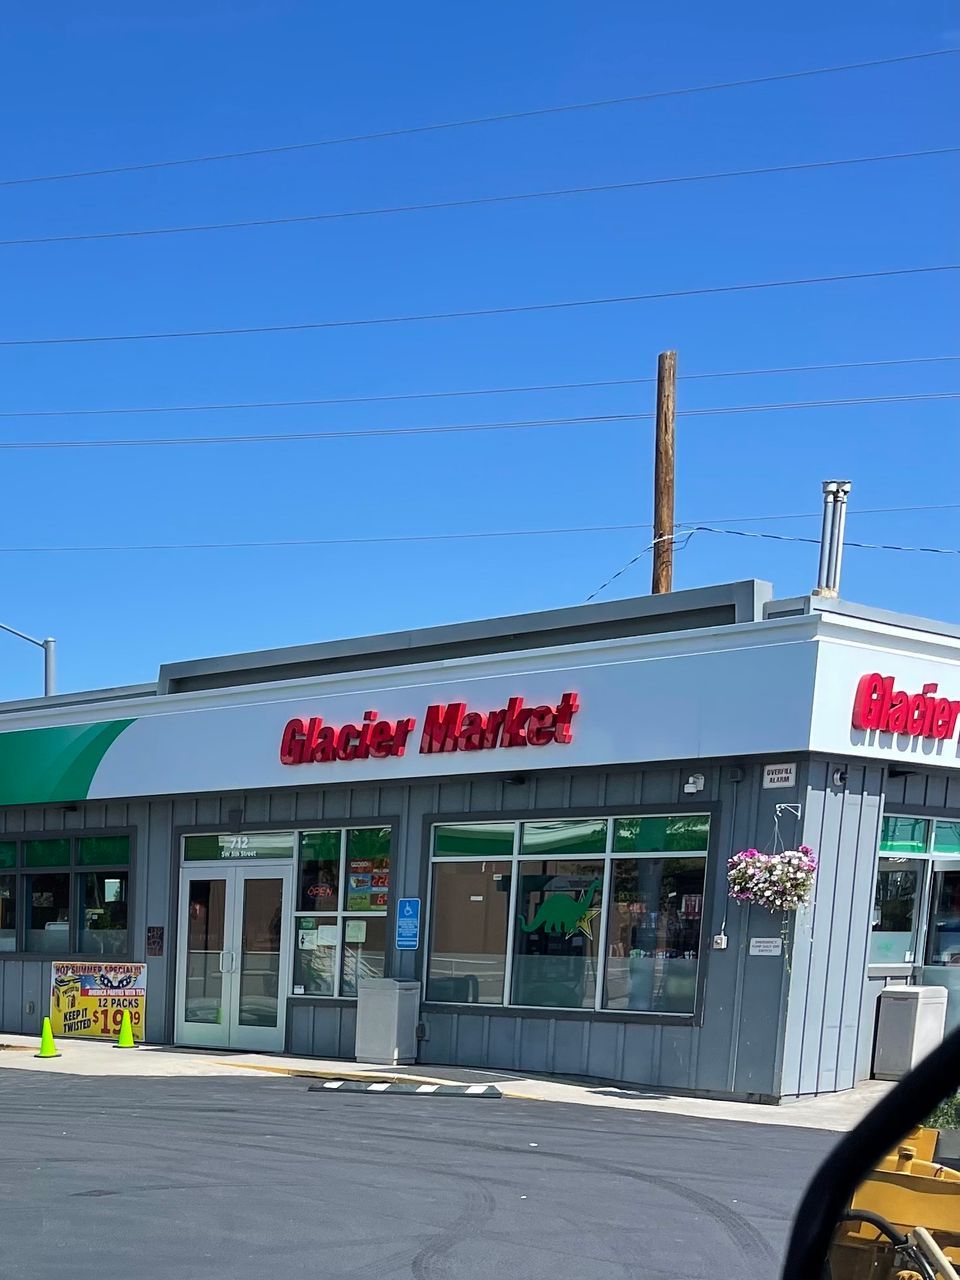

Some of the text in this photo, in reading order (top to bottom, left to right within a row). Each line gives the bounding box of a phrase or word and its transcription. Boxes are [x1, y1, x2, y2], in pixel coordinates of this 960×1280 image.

[851, 672, 960, 740] Glacier
[280, 693, 579, 765] Glacier Market
[769, 776, 790, 784] ALARM
[230, 836, 249, 849] 712
[307, 885, 333, 897] OPEN
[56, 964, 69, 975] HOT
[71, 964, 103, 975] SUMMER
[98, 998, 139, 1009] 12 PACKS
[63, 1007, 88, 1023] KEEP IT
[63, 1018, 92, 1034] TWISTED
